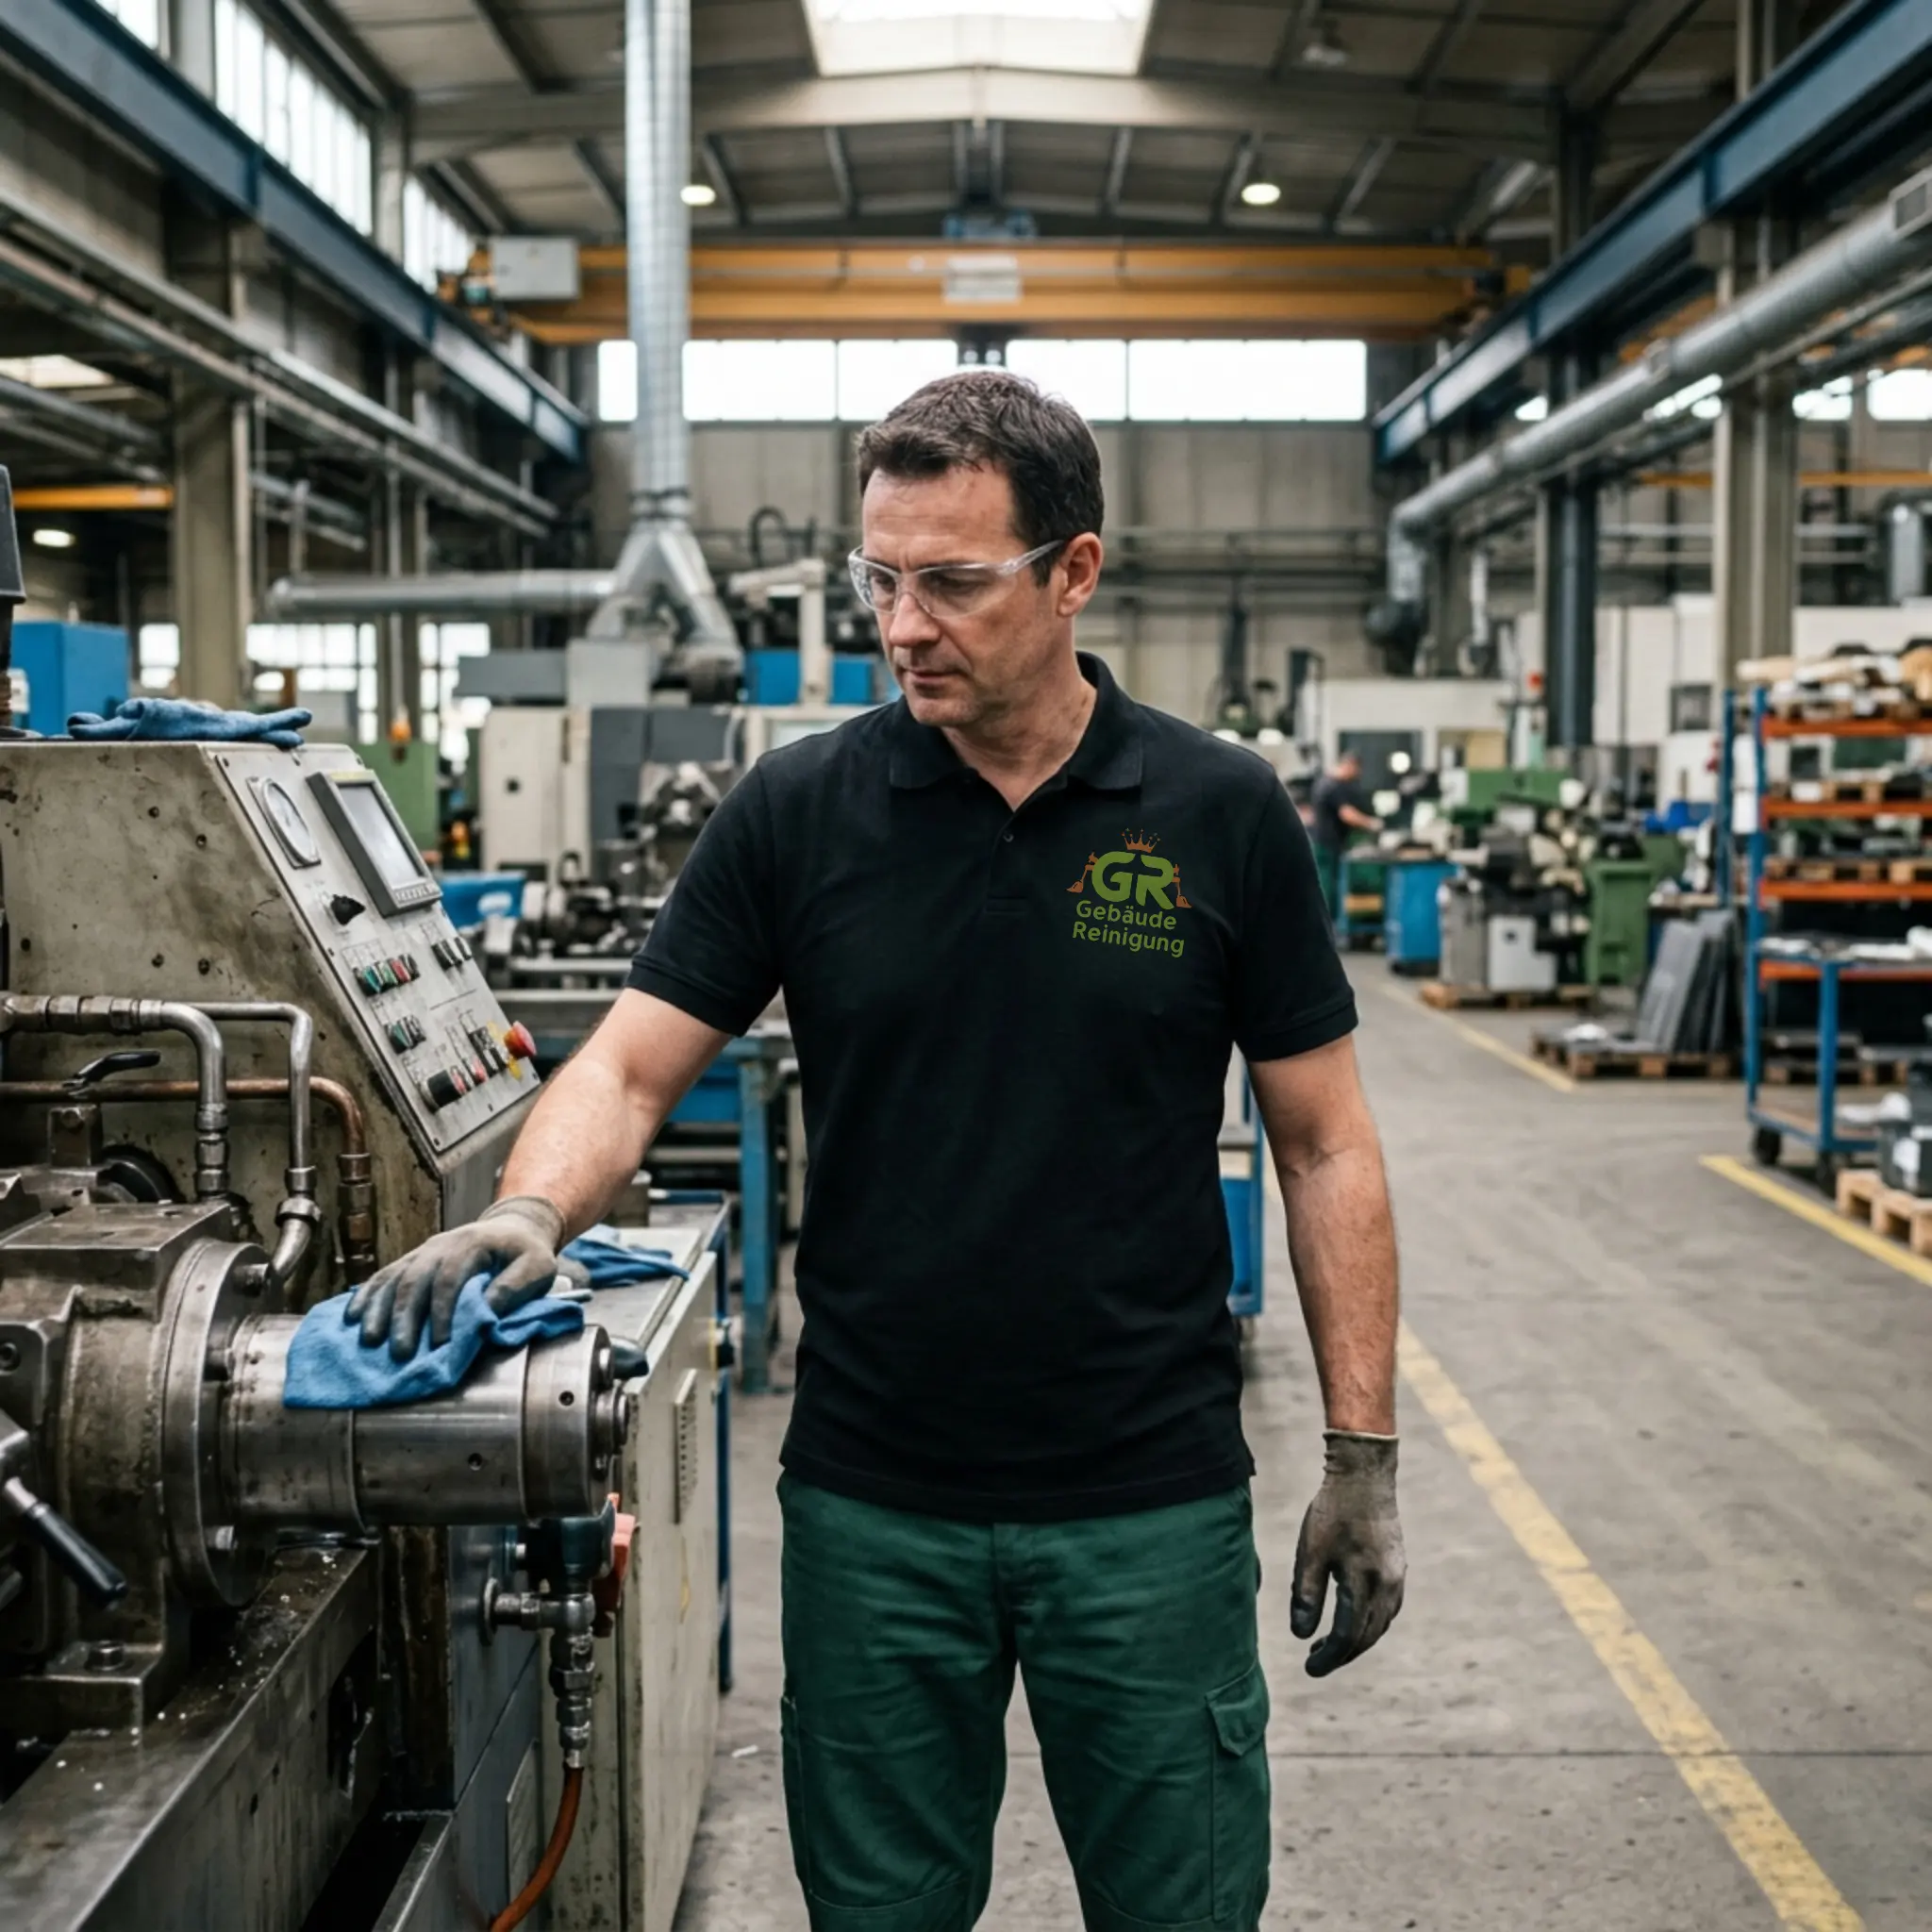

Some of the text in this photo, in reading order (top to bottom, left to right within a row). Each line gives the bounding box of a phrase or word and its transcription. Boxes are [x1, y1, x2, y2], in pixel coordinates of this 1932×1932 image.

[1091, 851, 1174, 909] GR
[1076, 900, 1176, 930] Gebäude
[1073, 922, 1184, 958] Reinigung
